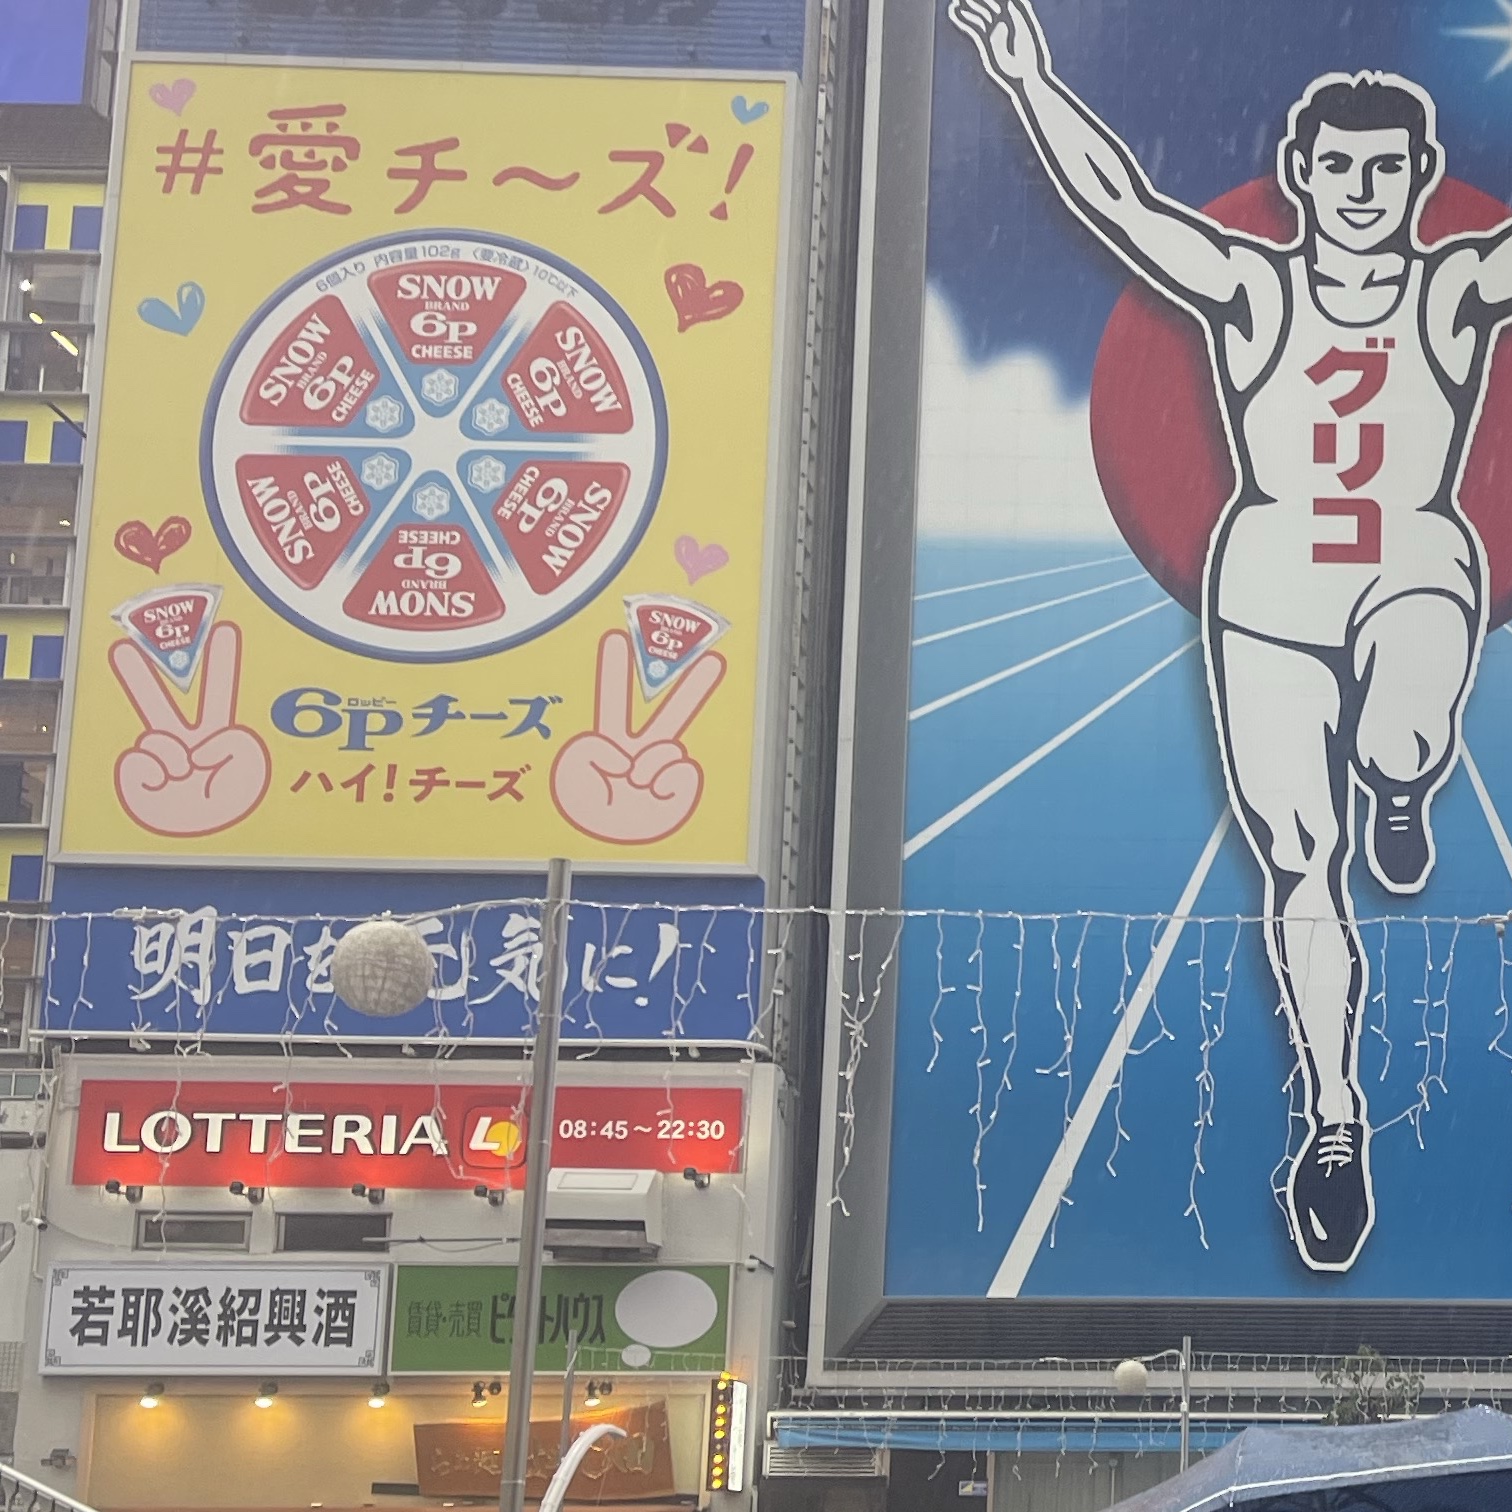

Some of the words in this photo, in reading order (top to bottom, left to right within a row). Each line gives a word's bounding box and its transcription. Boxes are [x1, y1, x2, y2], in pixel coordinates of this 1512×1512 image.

[397, 274, 502, 301] SNOW
[424, 301, 470, 312] BRAND
[258, 312, 334, 407] SNOW
[297, 350, 329, 392] BRAND
[411, 344, 474, 360] CHEESE
[555, 326, 624, 414] SNOW
[331, 368, 376, 423] CHEESE
[505, 373, 545, 429] CHEESE
[556, 360, 584, 401] BRAND
[1303, 336, 1396, 565] グリコ
[326, 461, 364, 517] CHEESE
[497, 466, 541, 521] CHEESE
[246, 475, 315, 568] SNOW
[286, 490, 313, 532] BRAND
[541, 480, 613, 577] SNOW
[544, 499, 576, 538] BRAND
[398, 529, 461, 545] CHEESE
[368, 590, 476, 617] SNOW
[401, 578, 447, 590] BRAND
[143, 600, 195, 624] SNOW
[648, 610, 702, 634] SNOW
[101, 1111, 451, 1158] LOTTERIA
[490, 1292, 606, 1345] ピトハウス
